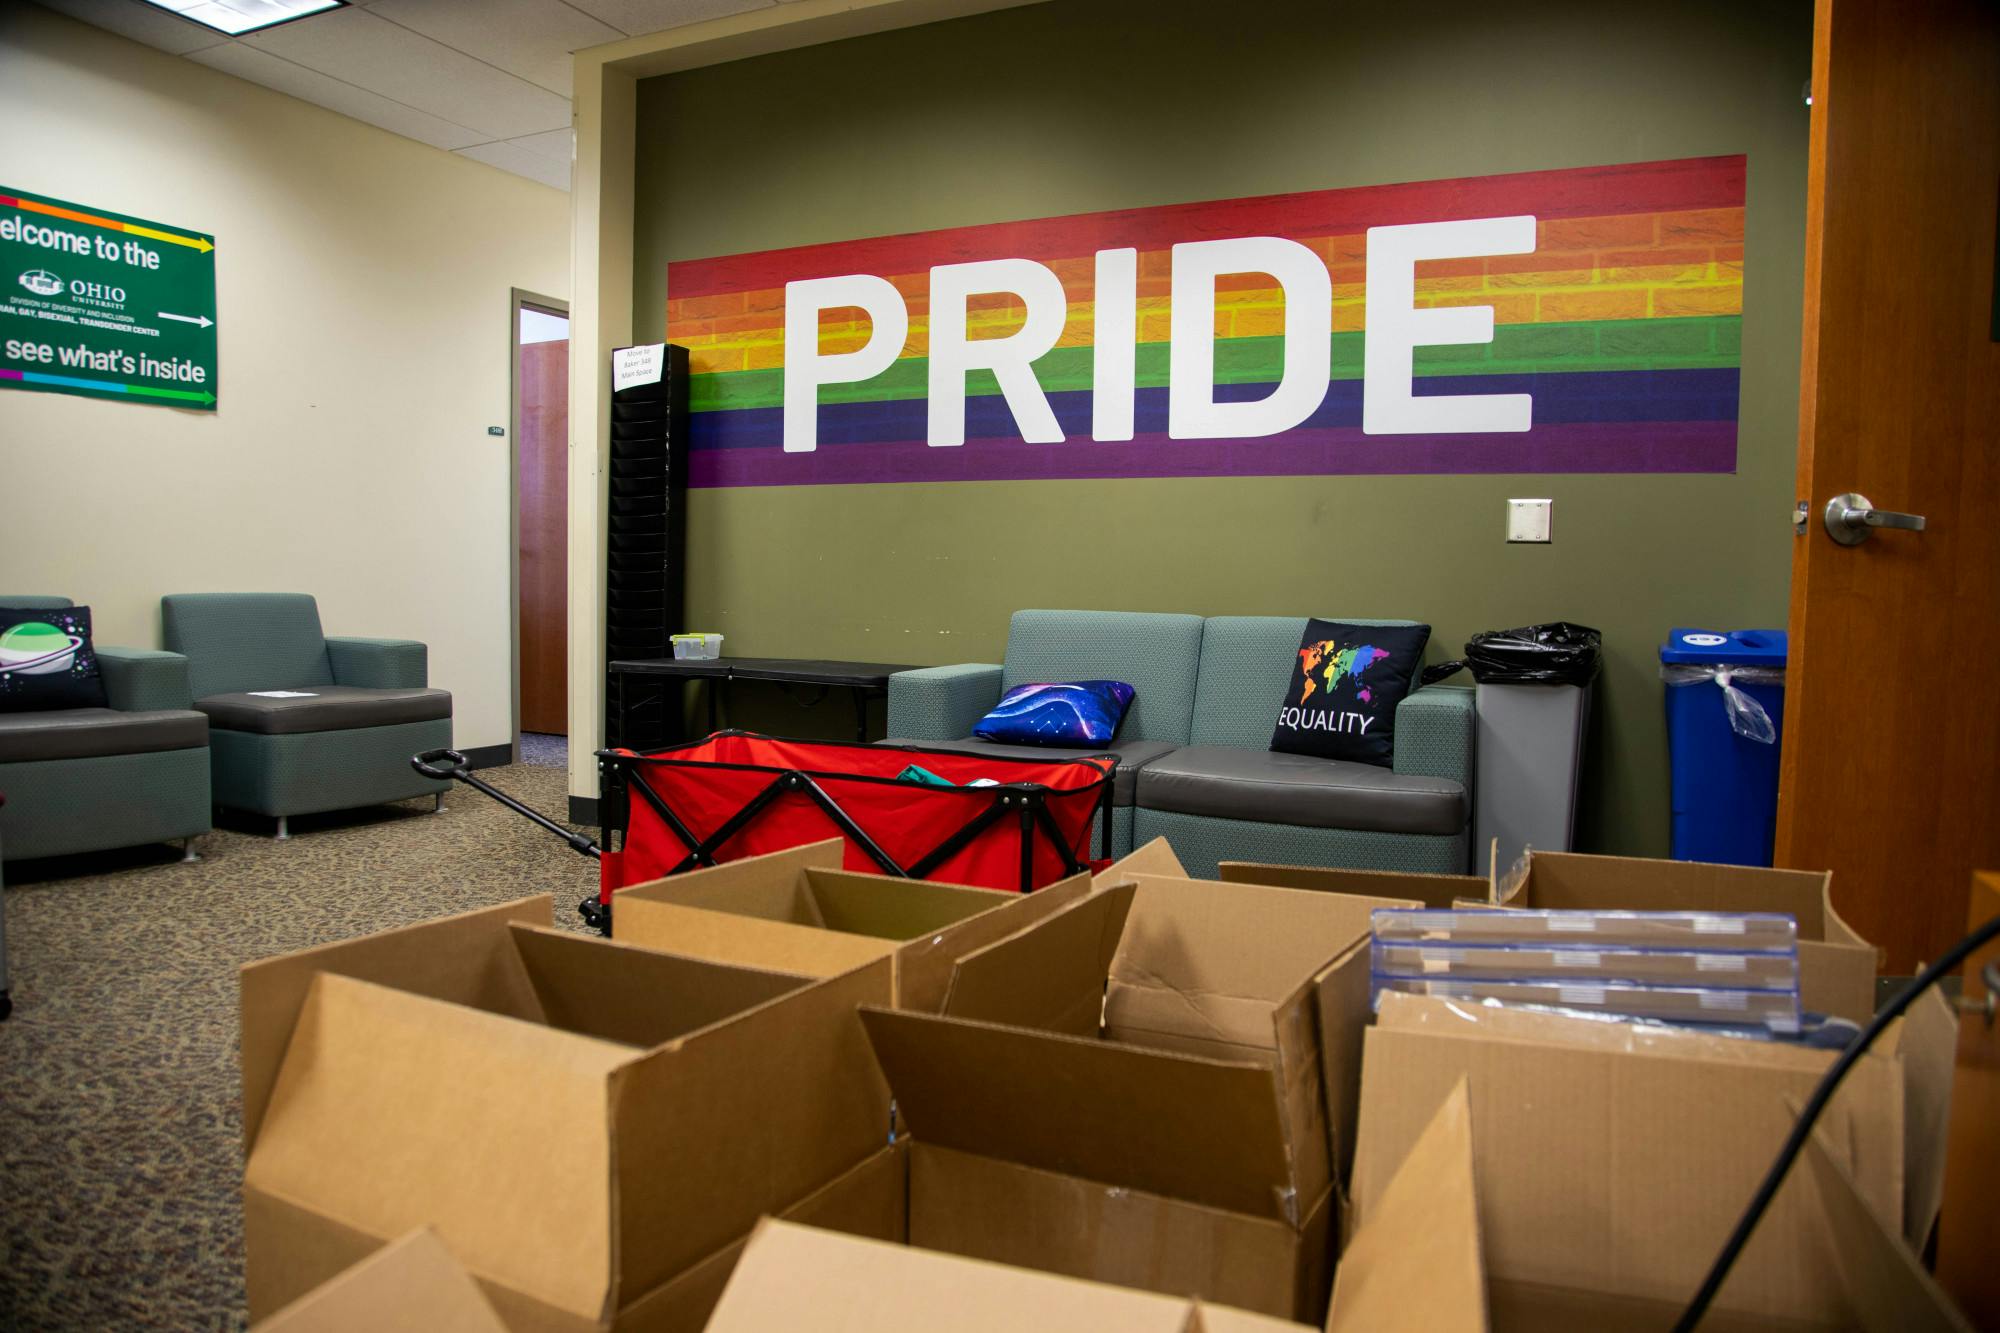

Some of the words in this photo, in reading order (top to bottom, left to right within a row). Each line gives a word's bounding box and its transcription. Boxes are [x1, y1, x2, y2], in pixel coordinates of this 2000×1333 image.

[0, 215, 91, 255] elcome
[96, 234, 120, 262] to
[123, 241, 160, 270] the
[70, 279, 126, 302] OHIO
[72, 295, 125, 310] UNIVERSITY
[41, 301, 50, 309] OF
[51, 303, 86, 315] DIVERSITY
[86, 309, 101, 319] AND
[79, 317, 132, 333] TRANSGENDER
[132, 325, 160, 337] CENTER
[782, 214, 1538, 453] PRIDE
[5, 339, 54, 364] see
[58, 344, 136, 375] what's
[140, 352, 206, 383] inside
[1278, 706, 1375, 736] EQUALITY
